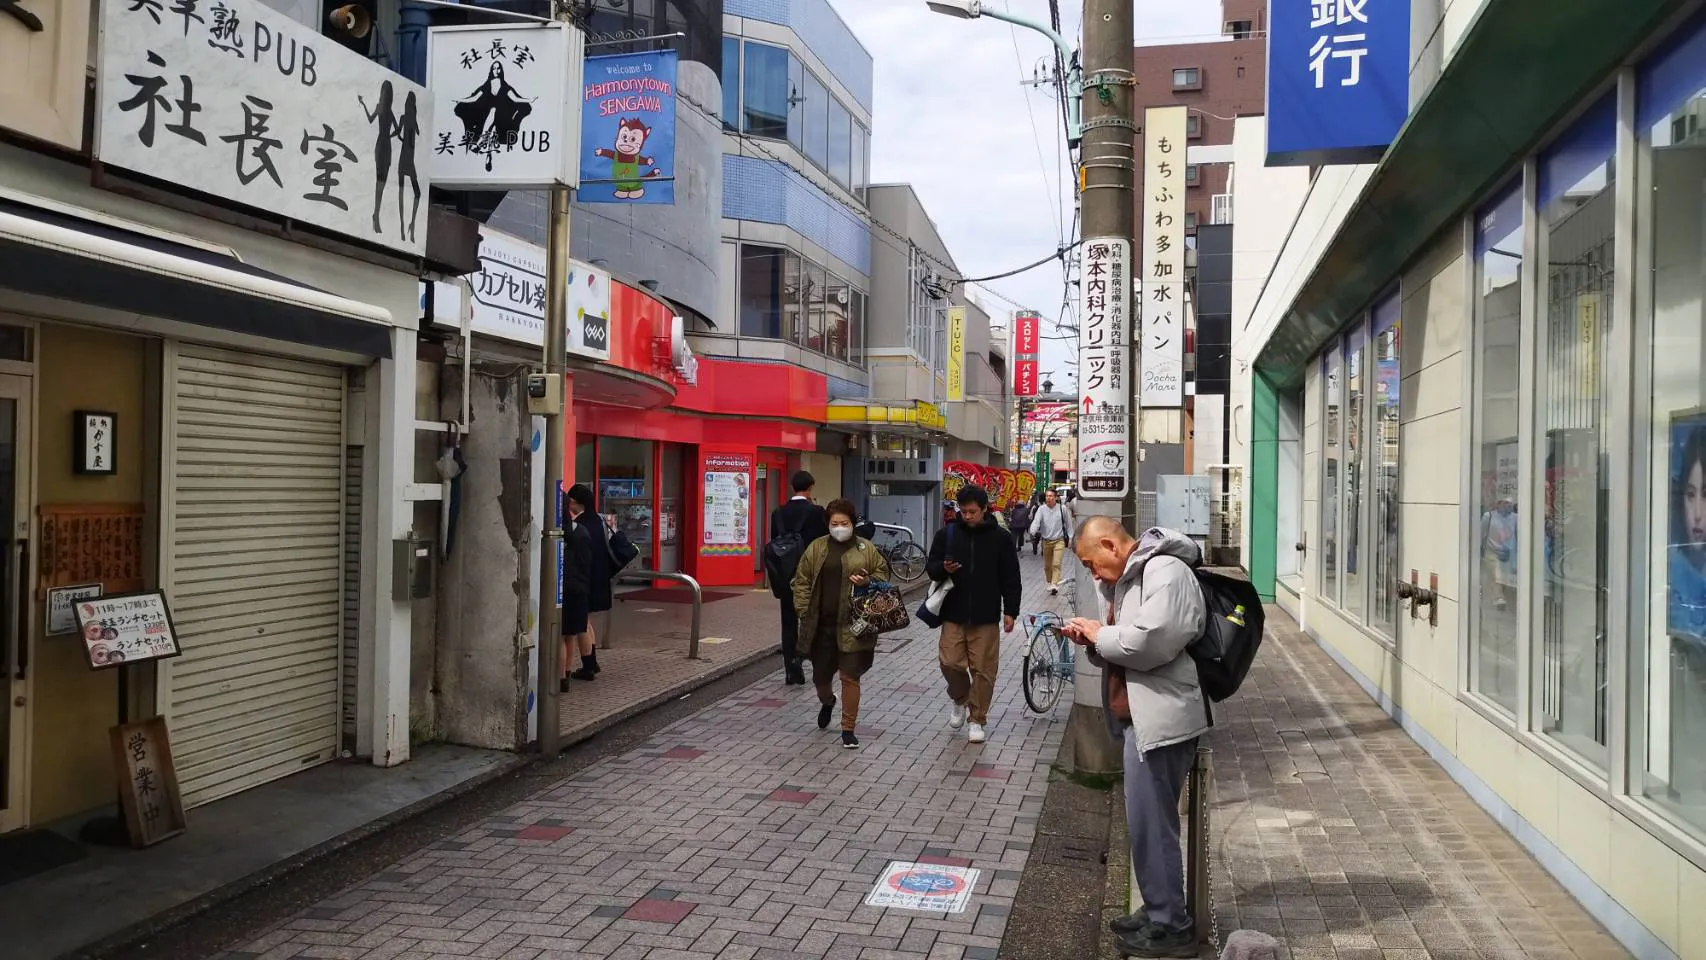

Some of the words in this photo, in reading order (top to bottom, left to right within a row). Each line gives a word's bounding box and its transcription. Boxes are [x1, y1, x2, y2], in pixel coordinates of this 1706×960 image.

[253, 21, 317, 87] PUB
[460, 38, 535, 70] 社長室
[1309, 0, 1369, 89] 銀行
[643, 62, 652, 72] to
[585, 76, 673, 101] Harmonytown
[599, 95, 661, 117] SENGAWA
[118, 50, 358, 211] 社長室
[506, 130, 551, 152] PUB
[1153, 136, 1174, 350] もちふわ多加水パン
[1087, 244, 1108, 390] 塚本内科クリニック
[1023, 321, 1032, 350] スロット
[1022, 362, 1031, 394] パチンコ
[705, 459, 749, 467] Information
[1108, 480, 1118, 488] 3-1
[128, 732, 161, 822] 営業中
